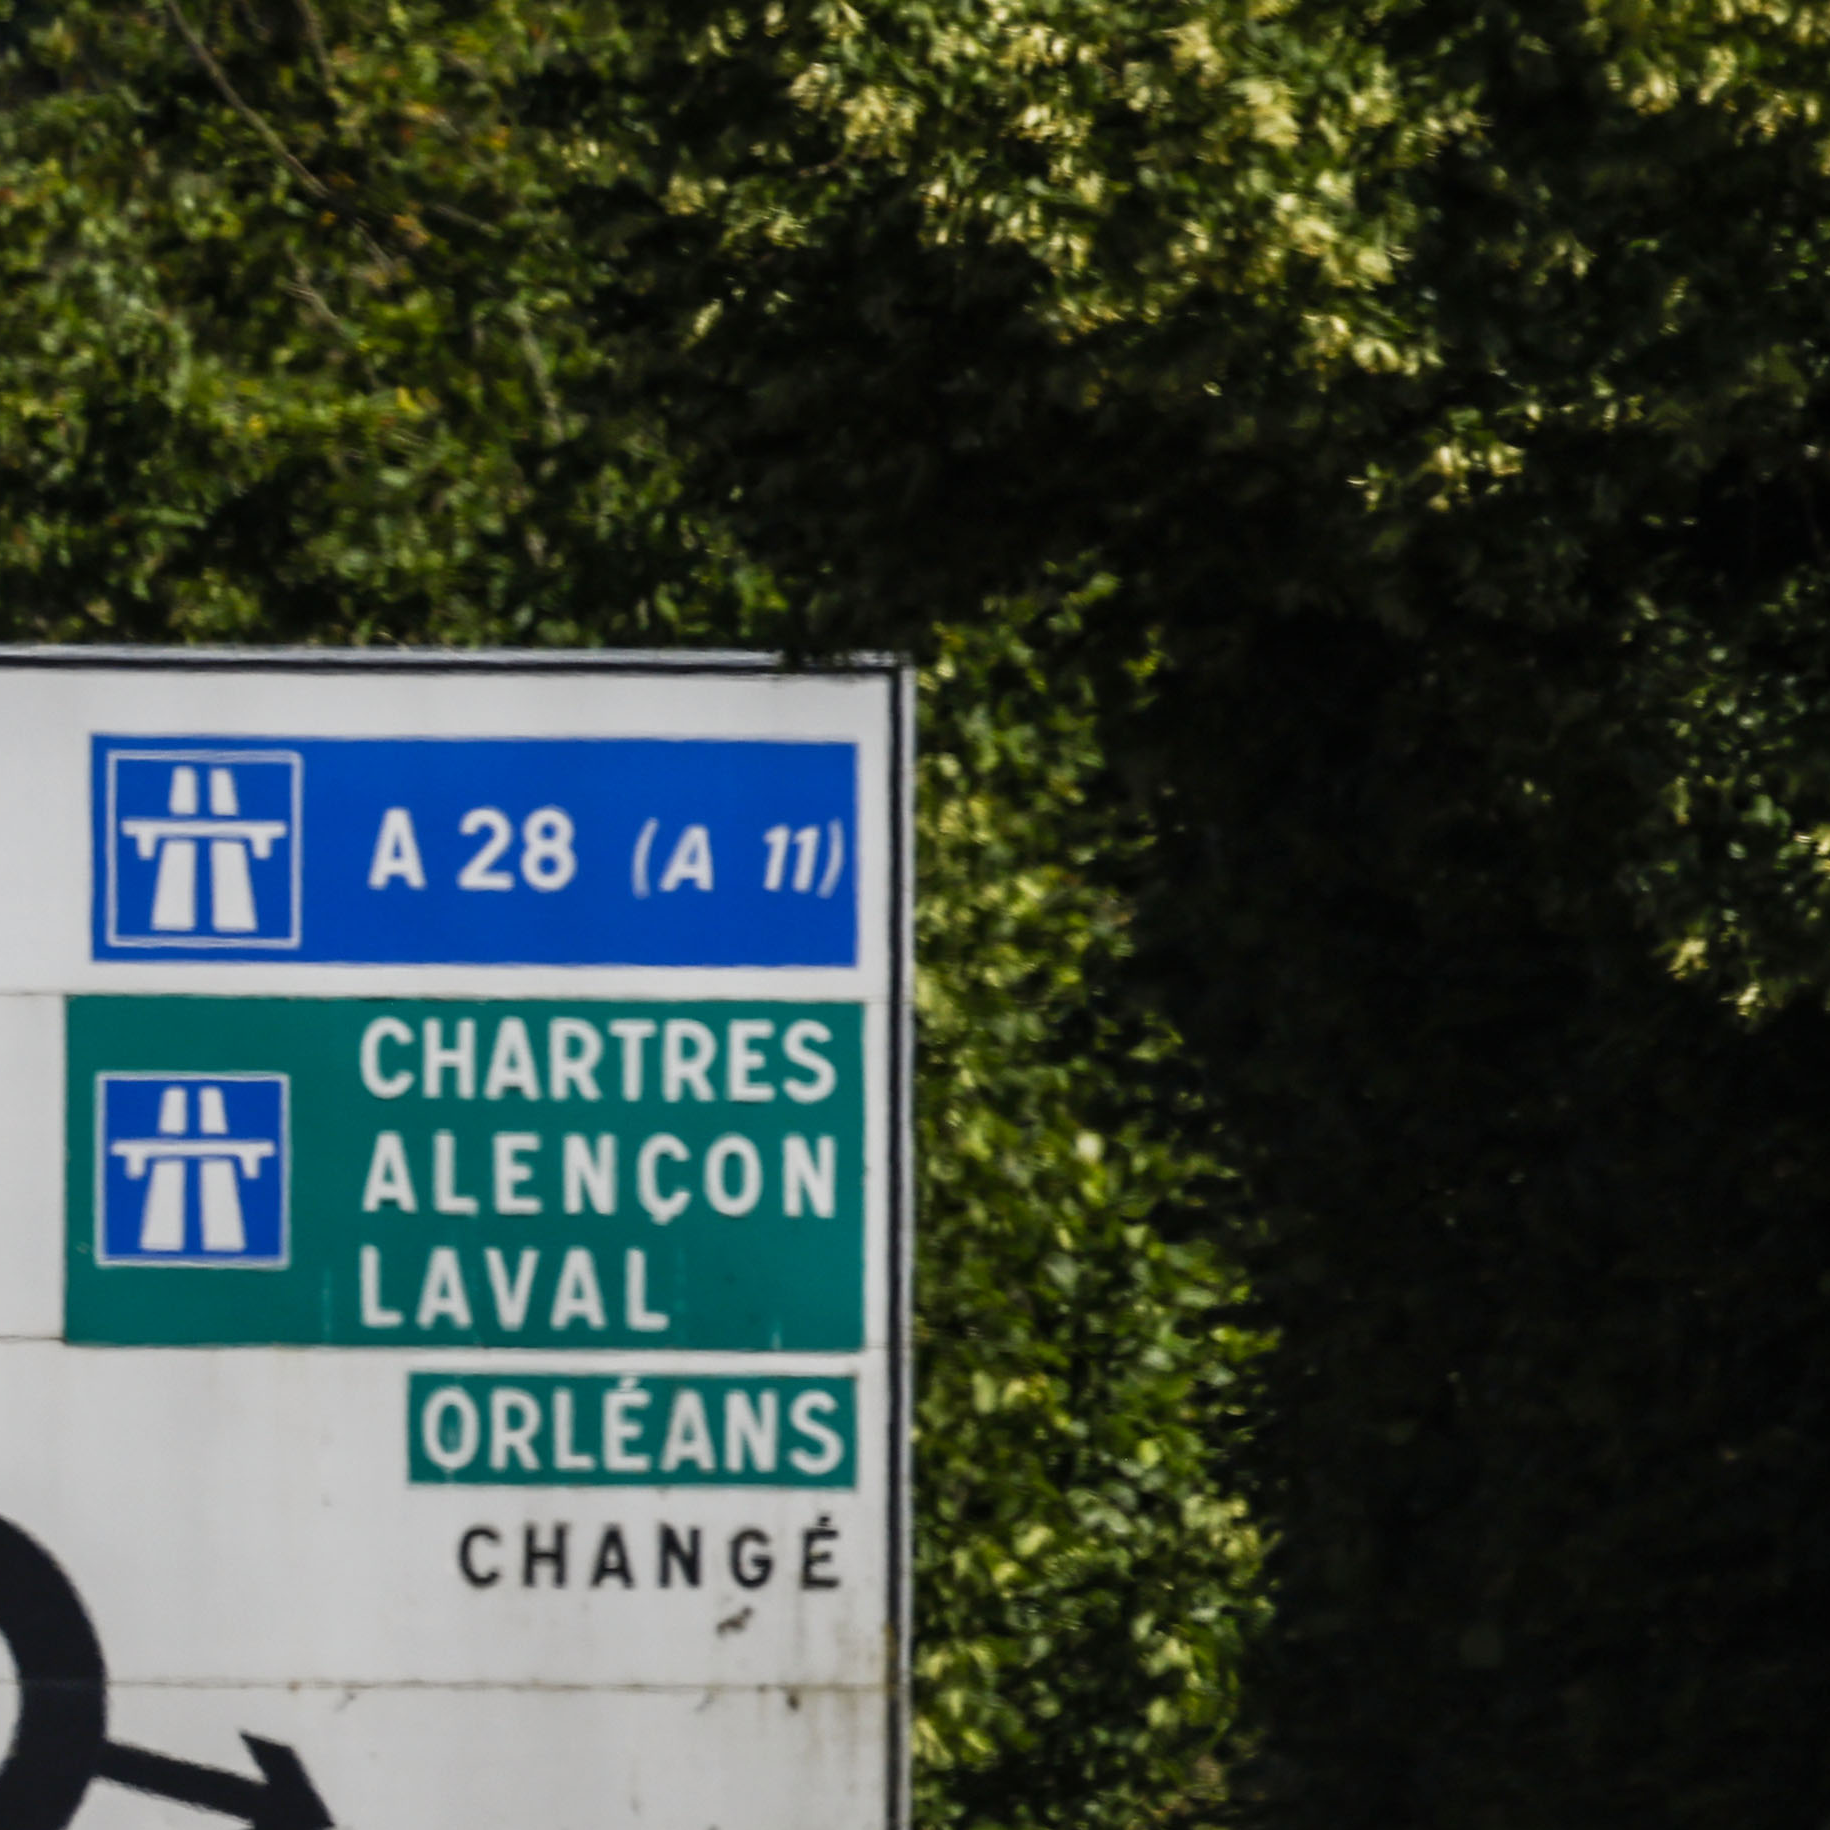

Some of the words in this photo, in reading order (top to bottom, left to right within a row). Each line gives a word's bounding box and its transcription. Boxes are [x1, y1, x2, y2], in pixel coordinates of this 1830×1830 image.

[368, 807, 426, 890] A
[458, 806, 577, 892] 28
[632, 817, 714, 897] (A
[763, 820, 844, 898] 11)
[359, 1016, 837, 1104] CHARTRES
[362, 1130, 836, 1225] ALENÇON
[359, 1244, 670, 1332] LAVAL
[421, 1374, 844, 1476] ORLÉANS
[457, 1514, 841, 1592] CHANGÉ
